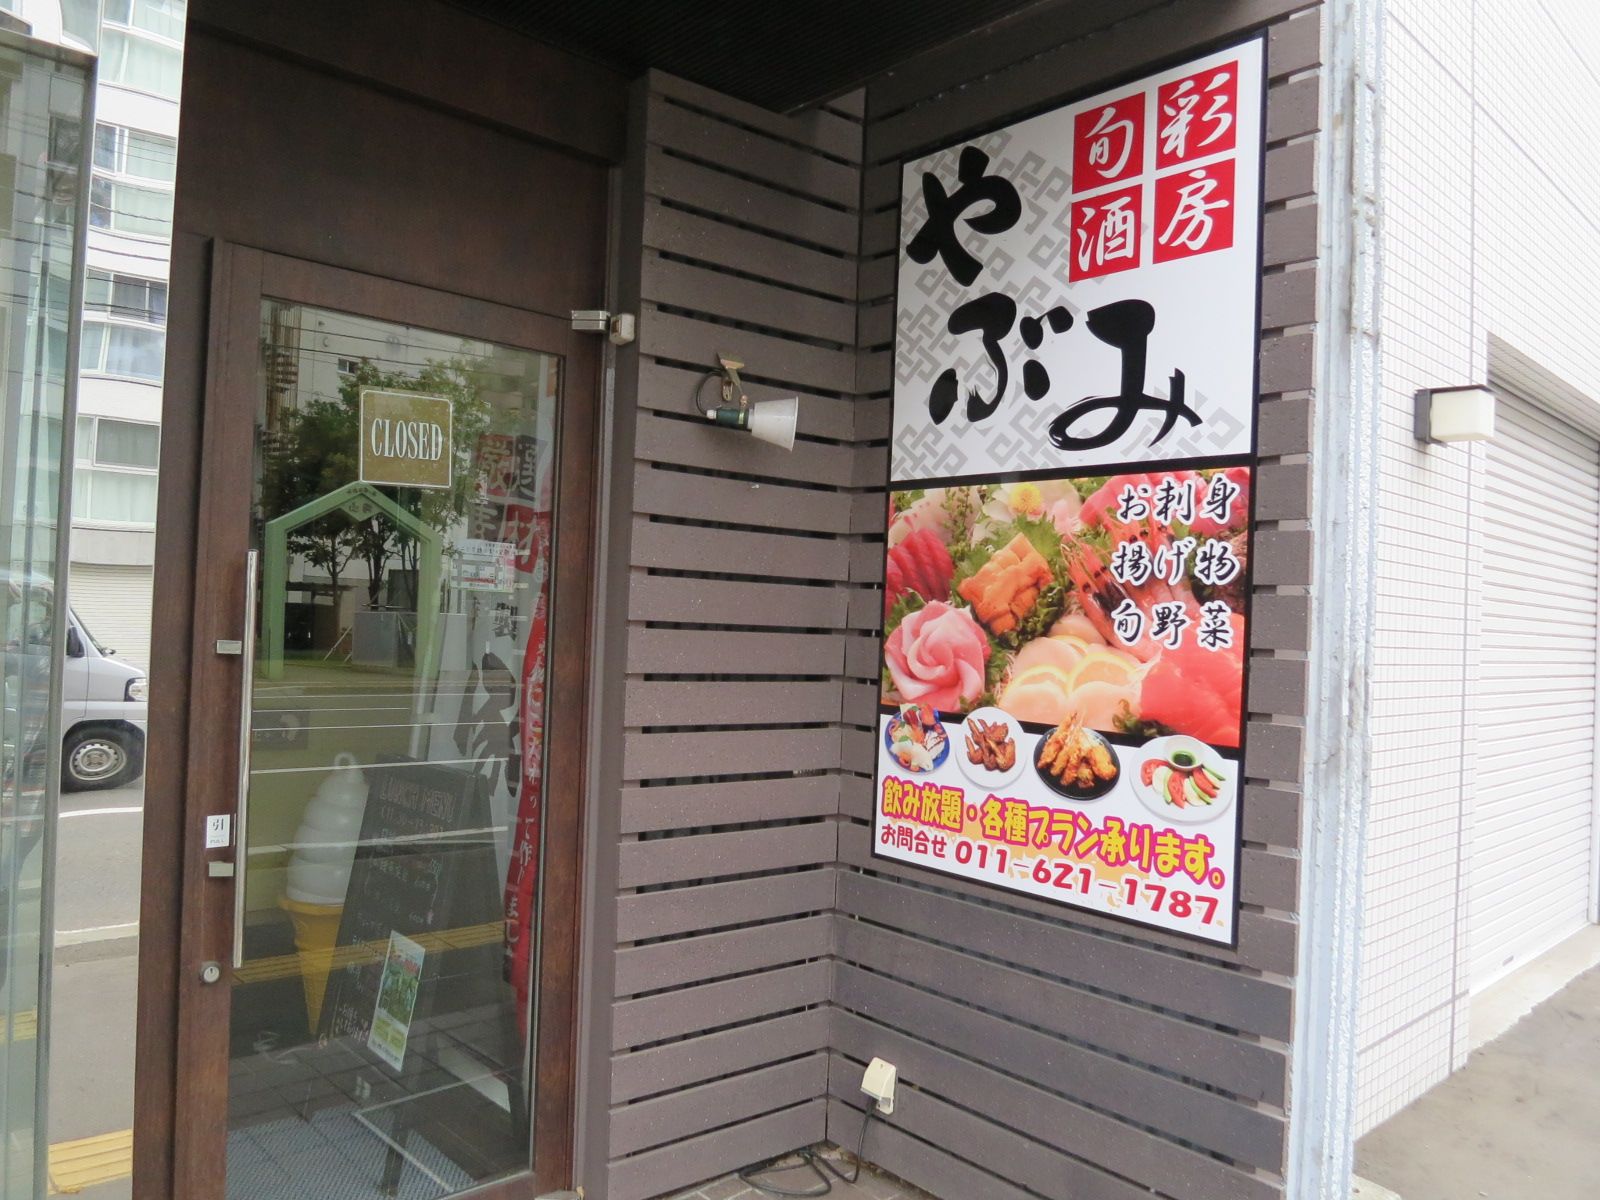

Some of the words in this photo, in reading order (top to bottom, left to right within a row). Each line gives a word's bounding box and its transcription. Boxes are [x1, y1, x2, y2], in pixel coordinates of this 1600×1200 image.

[371, 417, 444, 461] CLOSED
[1118, 474, 1238, 523] お刺身
[1112, 539, 1238, 584] 揚げ物
[1112, 601, 1232, 649] 旬野菜
[881, 823, 948, 858] お問合せ
[955, 840, 1219, 925] 011-621-1787
